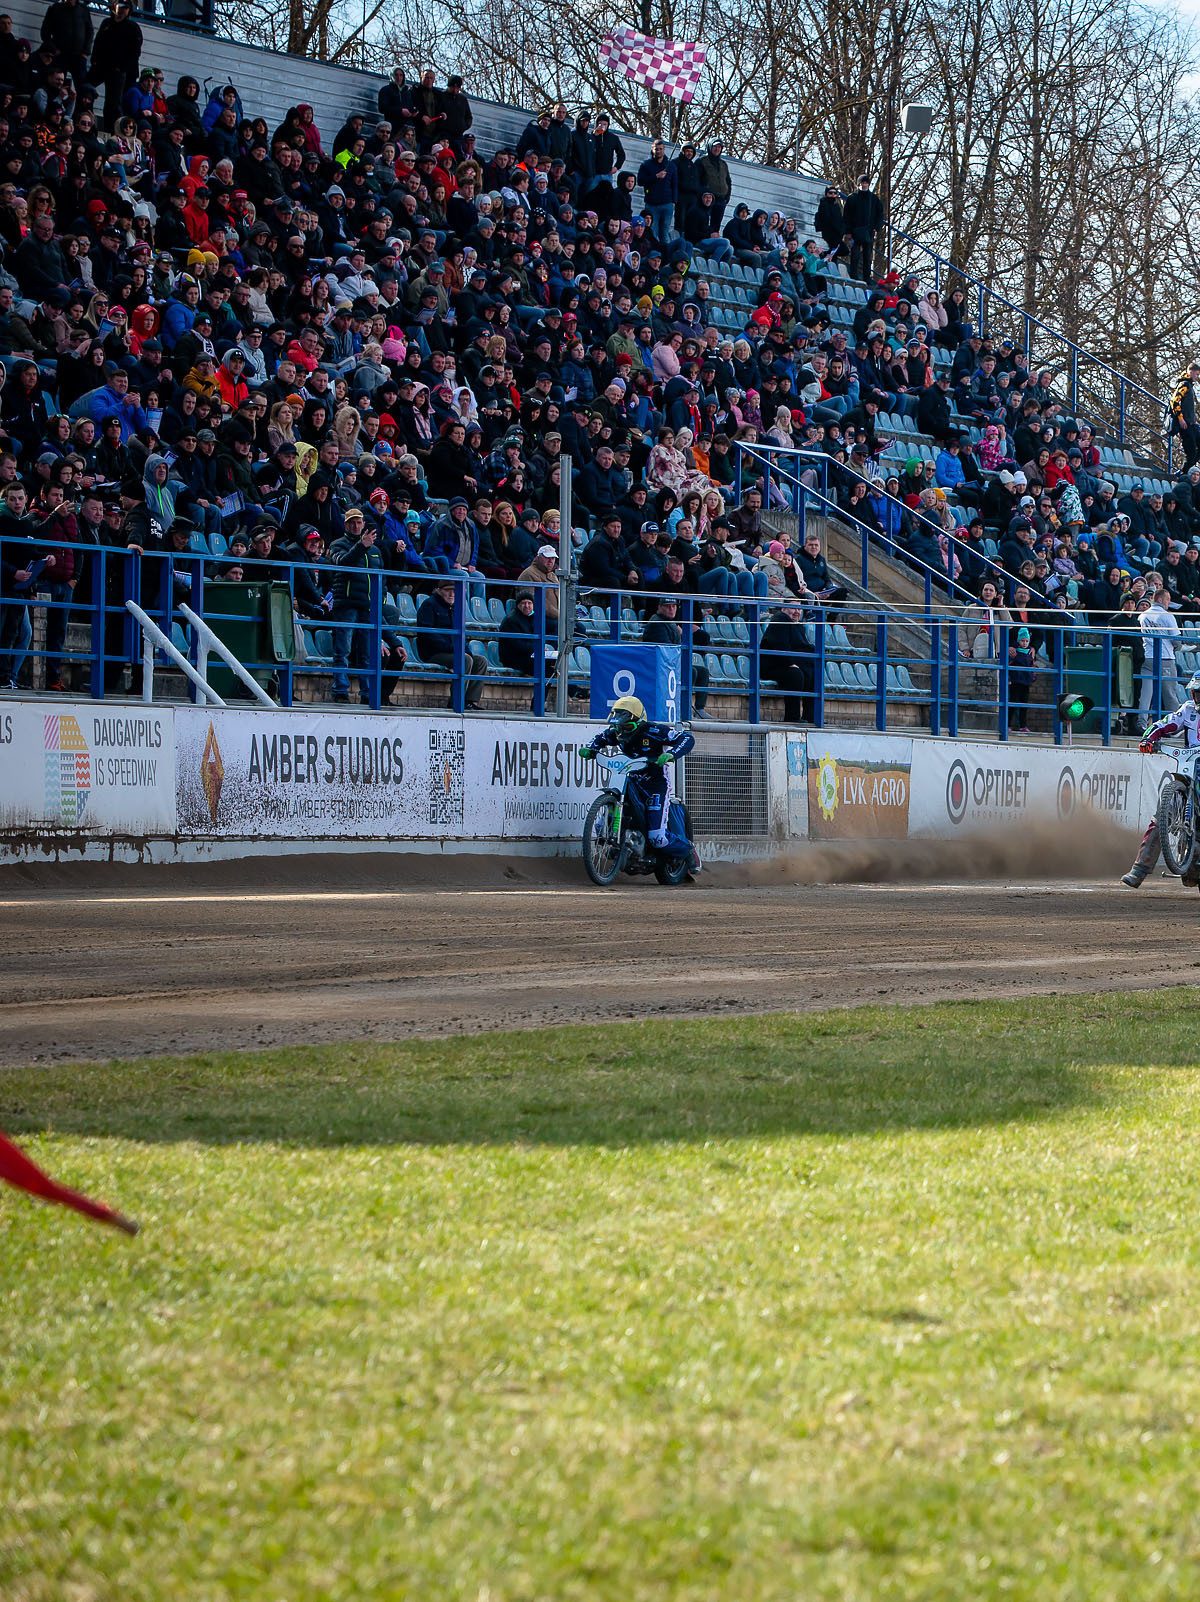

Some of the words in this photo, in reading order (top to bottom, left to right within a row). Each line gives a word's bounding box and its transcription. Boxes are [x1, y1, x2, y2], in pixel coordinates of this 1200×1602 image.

[93, 718, 162, 748] DAUGAVPILS
[95, 758, 105, 786] IS
[107, 758, 157, 787] SPEEDWAY
[248, 733, 319, 784] AMBER
[324, 735, 404, 785] STUDIOS
[491, 740, 550, 787] AMBER
[553, 742, 613, 789] STUDIO
[843, 776, 867, 805] LVK
[871, 776, 906, 807] AGRO
[972, 767, 1030, 808] OPTIBET
[1080, 772, 1131, 811] OPTIBET
